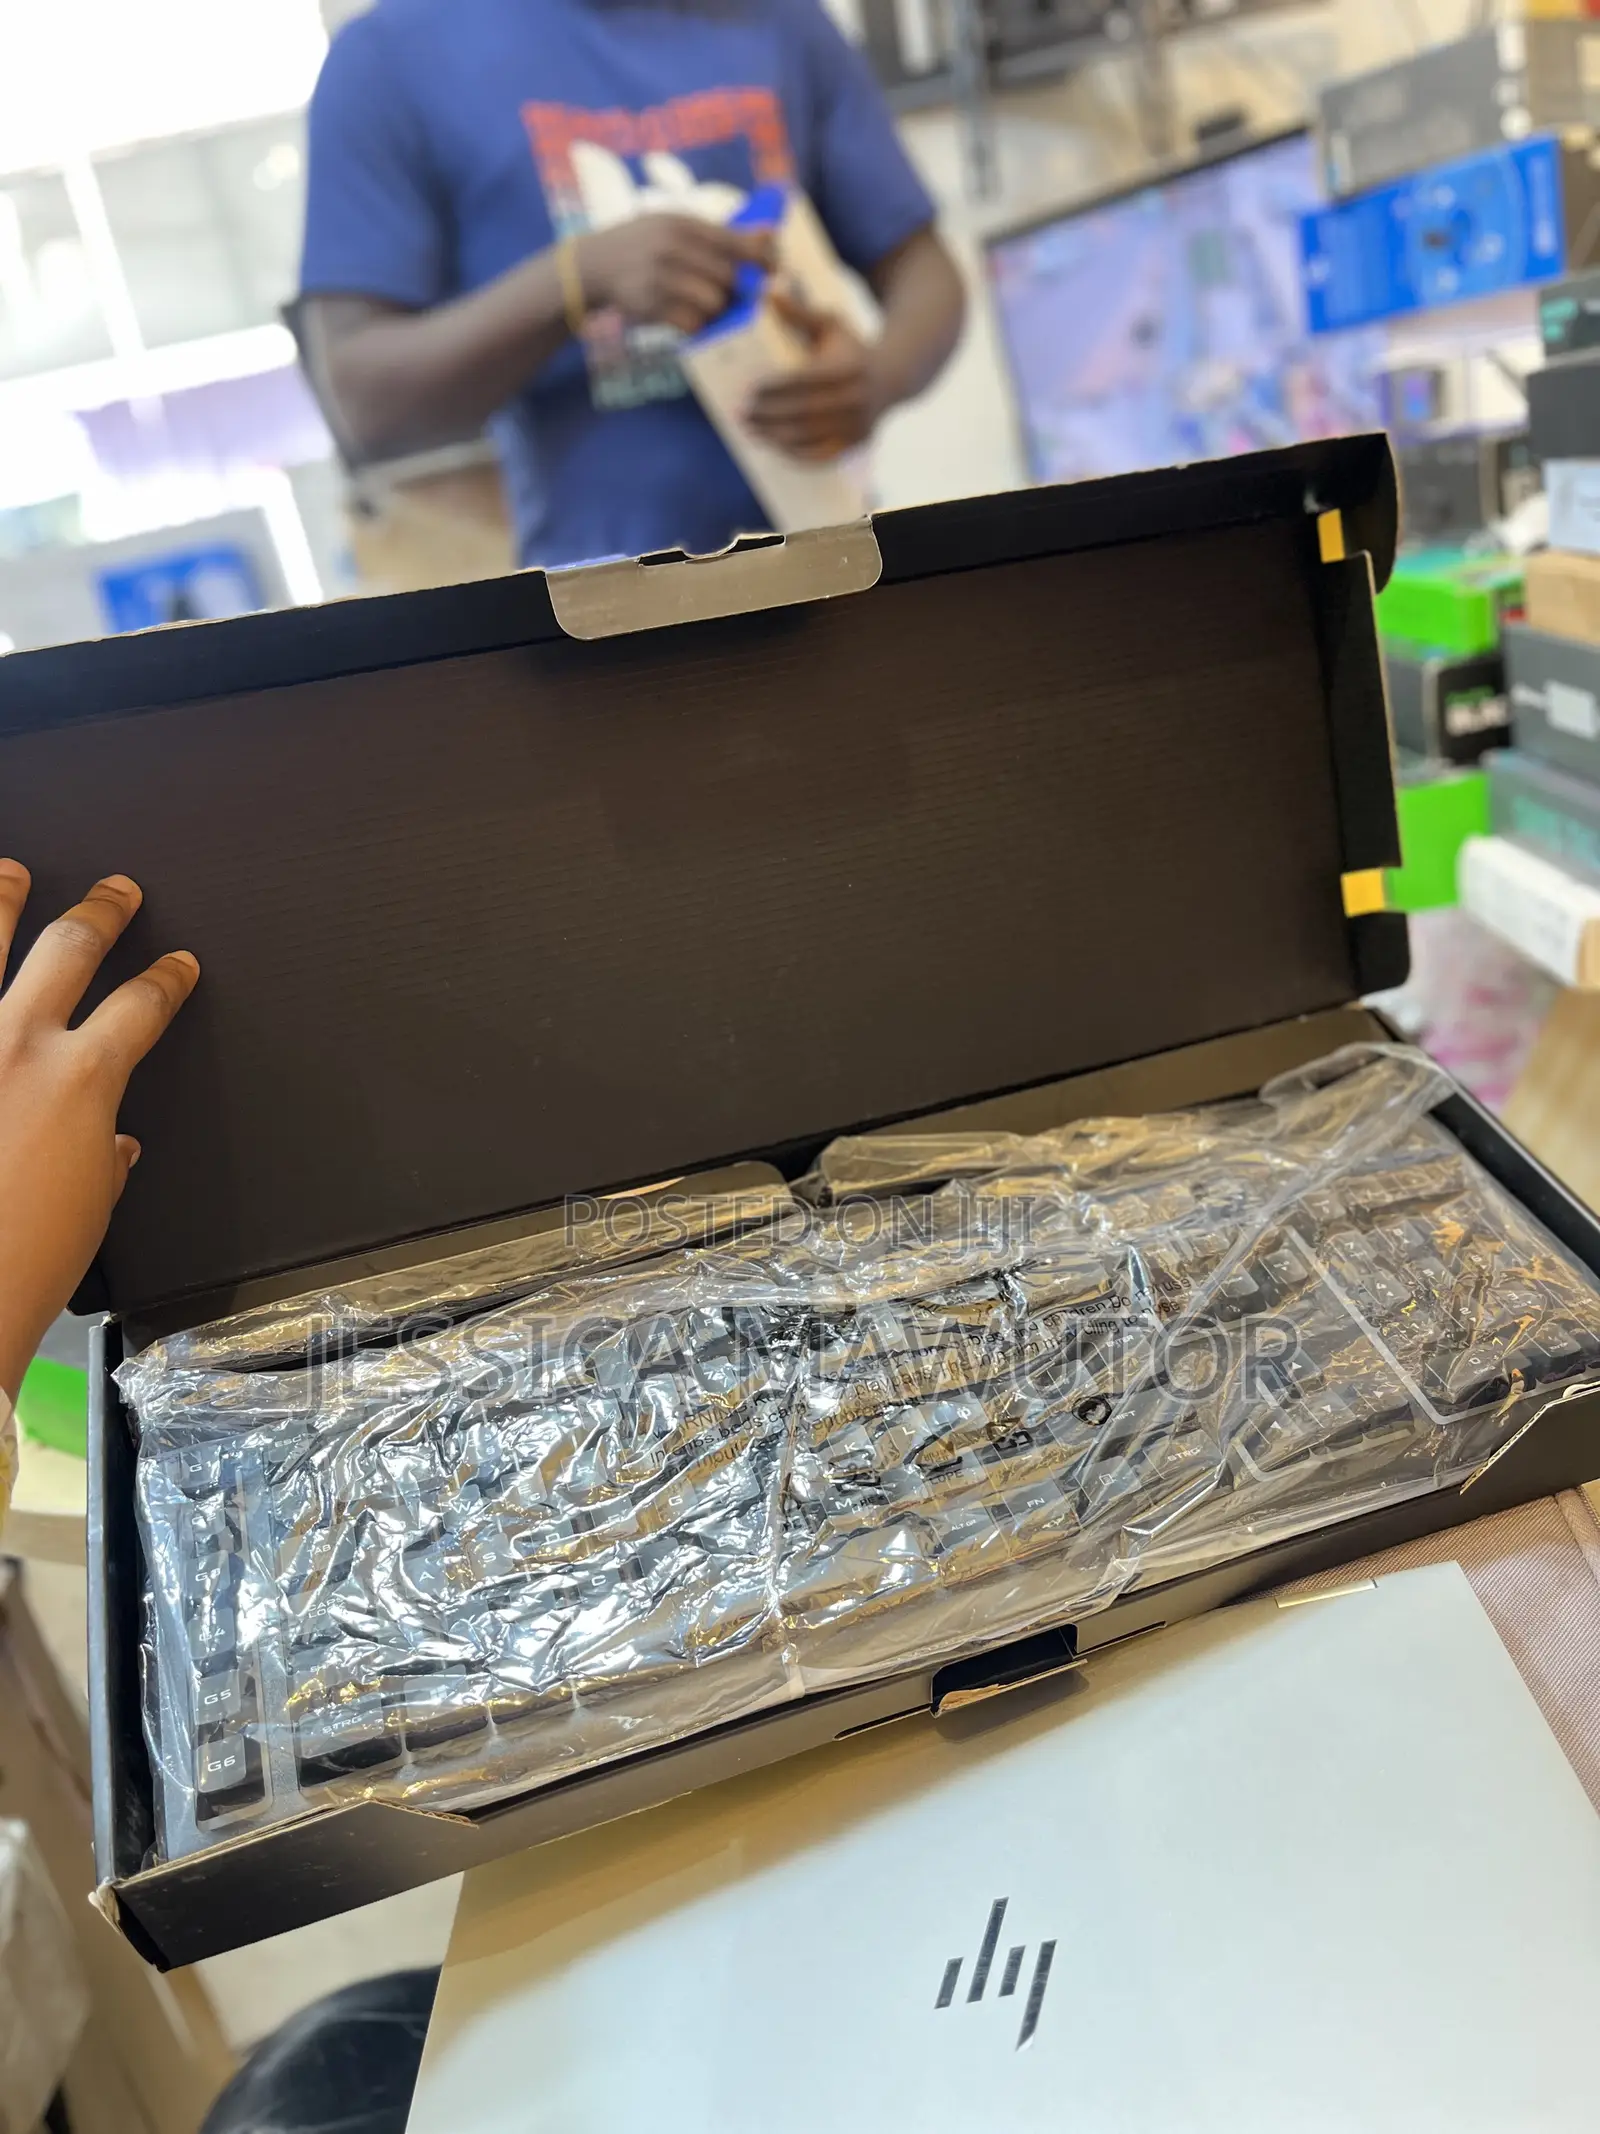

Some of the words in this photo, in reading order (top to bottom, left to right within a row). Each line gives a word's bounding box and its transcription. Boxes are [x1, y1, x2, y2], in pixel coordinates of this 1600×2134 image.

[1026, 1497, 1045, 1508] FN
[203, 1688, 233, 1706] G5
[206, 1754, 237, 1773] G6
